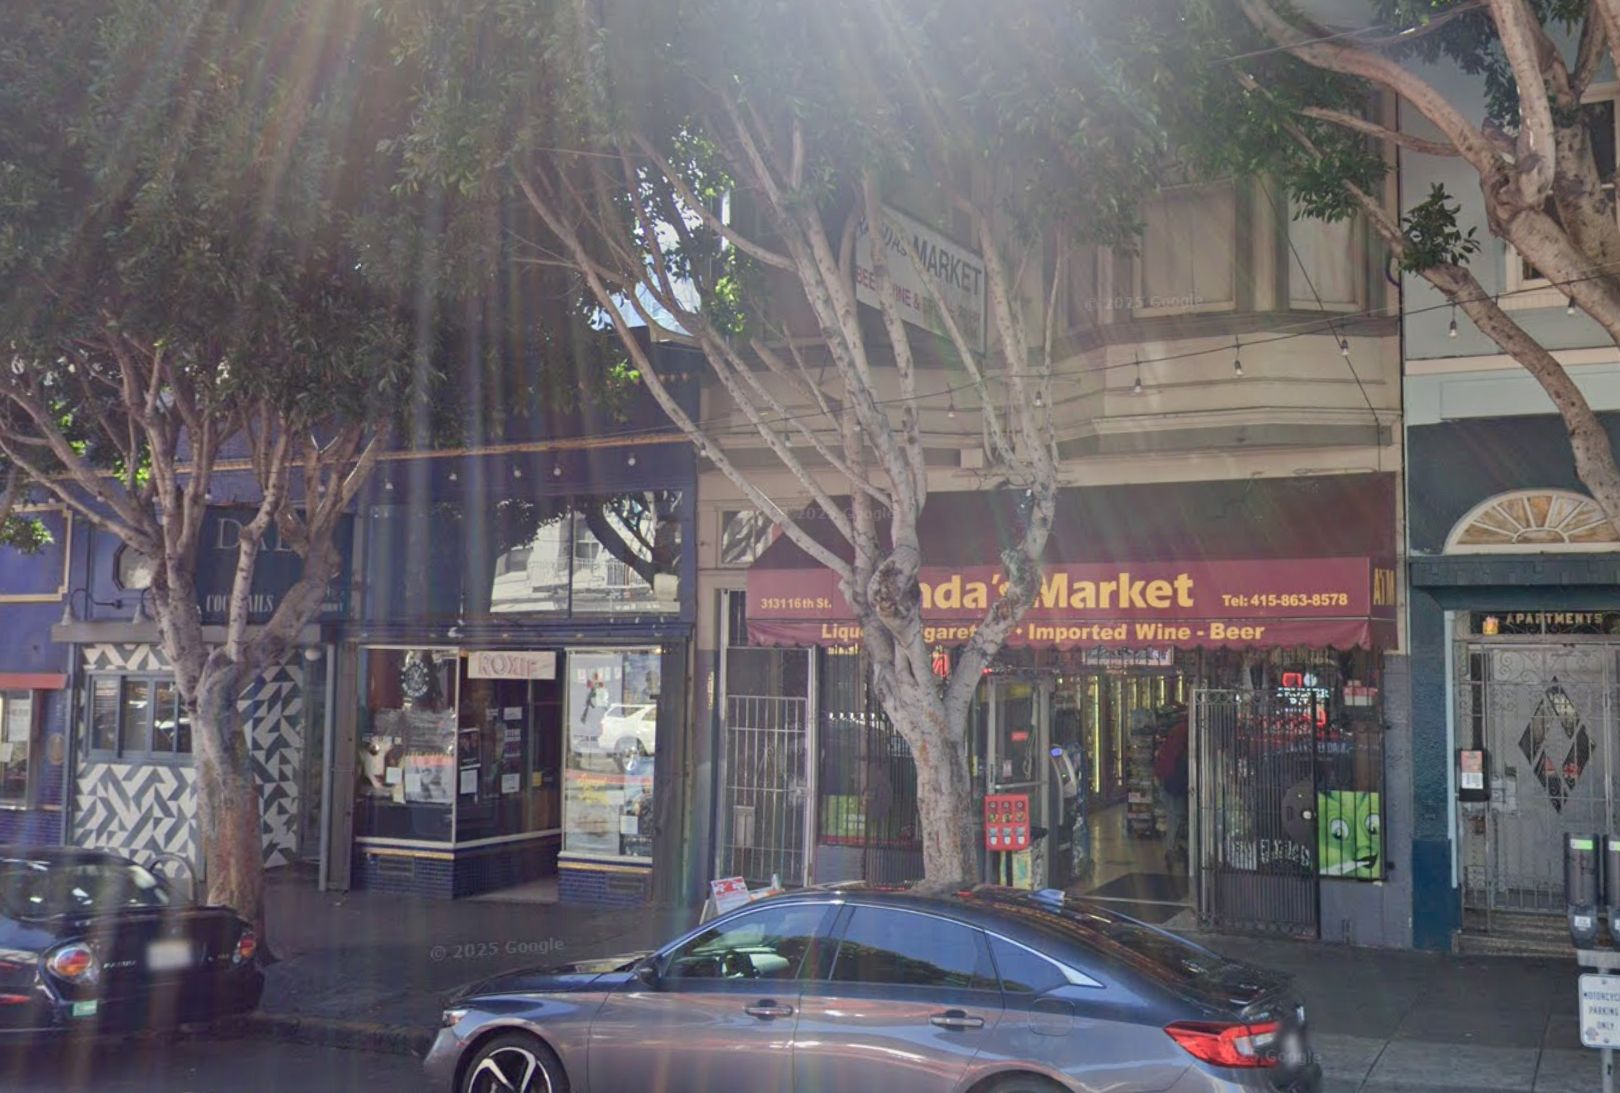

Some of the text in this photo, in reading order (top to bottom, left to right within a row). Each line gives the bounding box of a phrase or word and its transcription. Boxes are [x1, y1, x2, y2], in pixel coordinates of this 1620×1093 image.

[913, 234, 982, 296] MARKET
[856, 265, 880, 292] BEE
[1033, 572, 1194, 609] Market
[1373, 568, 1395, 606] ATM
[760, 597, 832, 609] 3131 16th St.
[1222, 593, 1348, 607] Tel: 415-863-8578
[1505, 612, 1604, 625] APARTMENTS
[822, 623, 864, 642] Liqu
[1028, 623, 1127, 644] Imported
[1135, 623, 1191, 640] Wine
[1209, 622, 1265, 640] Beer
[1583, 991, 1620, 1002] MOTORCYC
